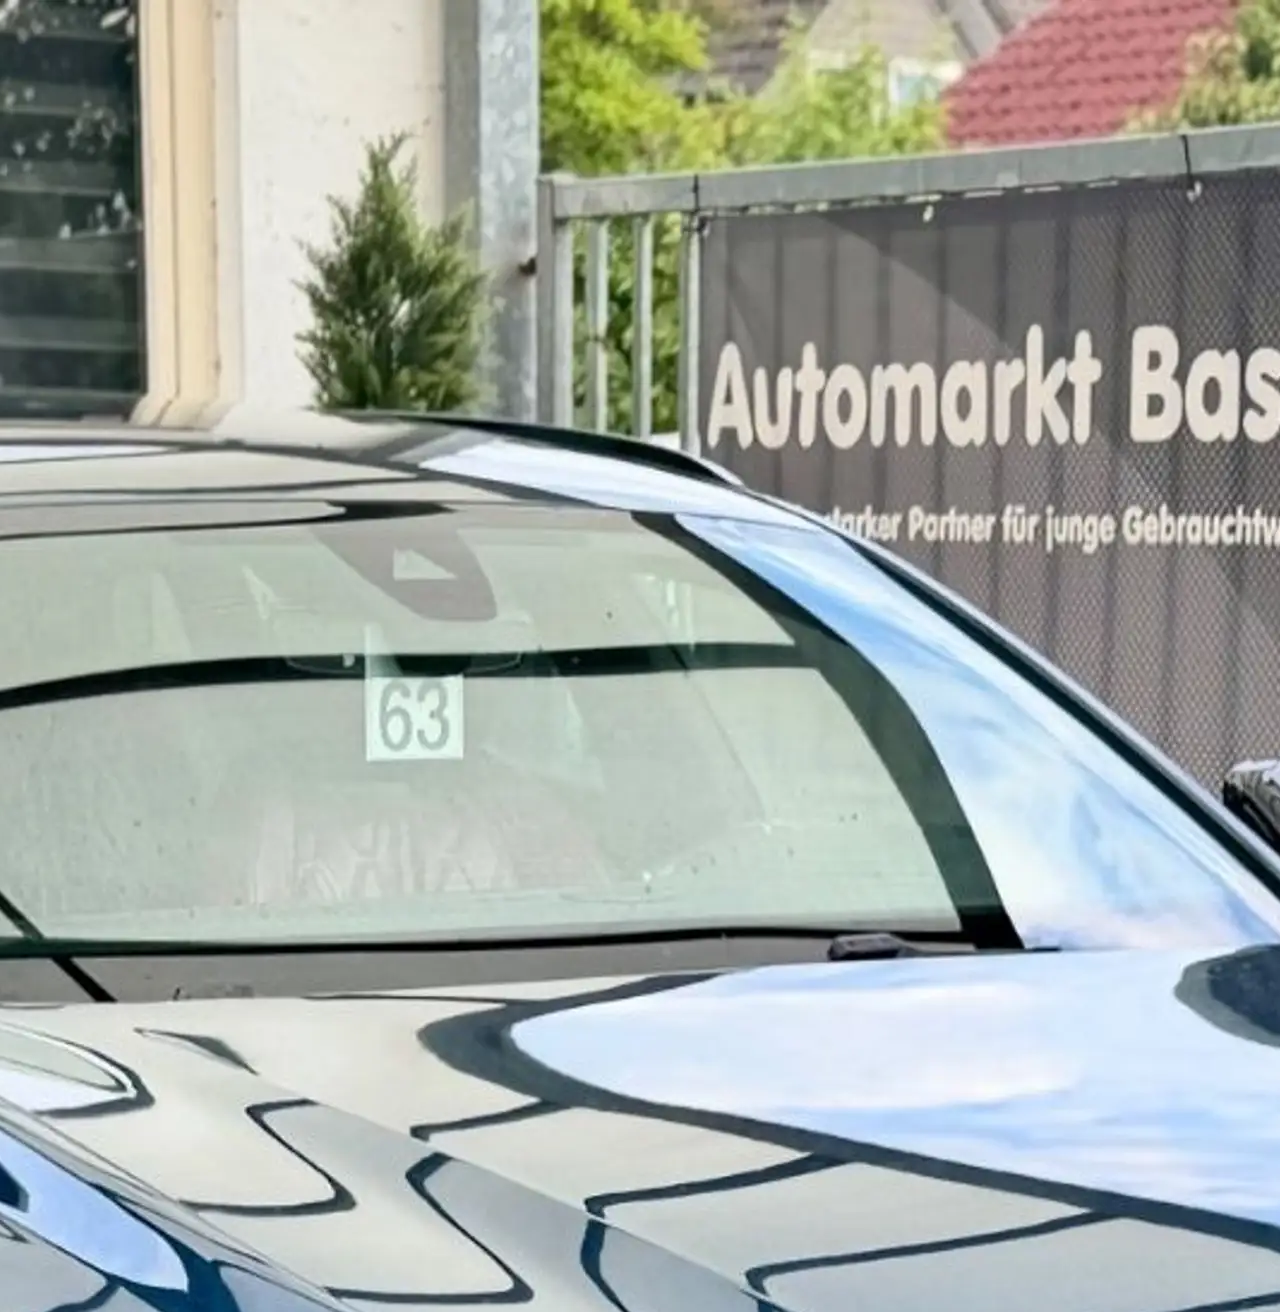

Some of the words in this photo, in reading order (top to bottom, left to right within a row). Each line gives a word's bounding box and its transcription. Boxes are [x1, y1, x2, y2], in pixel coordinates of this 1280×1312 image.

[707, 322, 1103, 450] Automarkt
[825, 504, 902, 541] tarker
[908, 504, 995, 542] Partner
[1002, 503, 1041, 544] für
[1045, 504, 1116, 556] junge
[379, 680, 450, 751] 63
